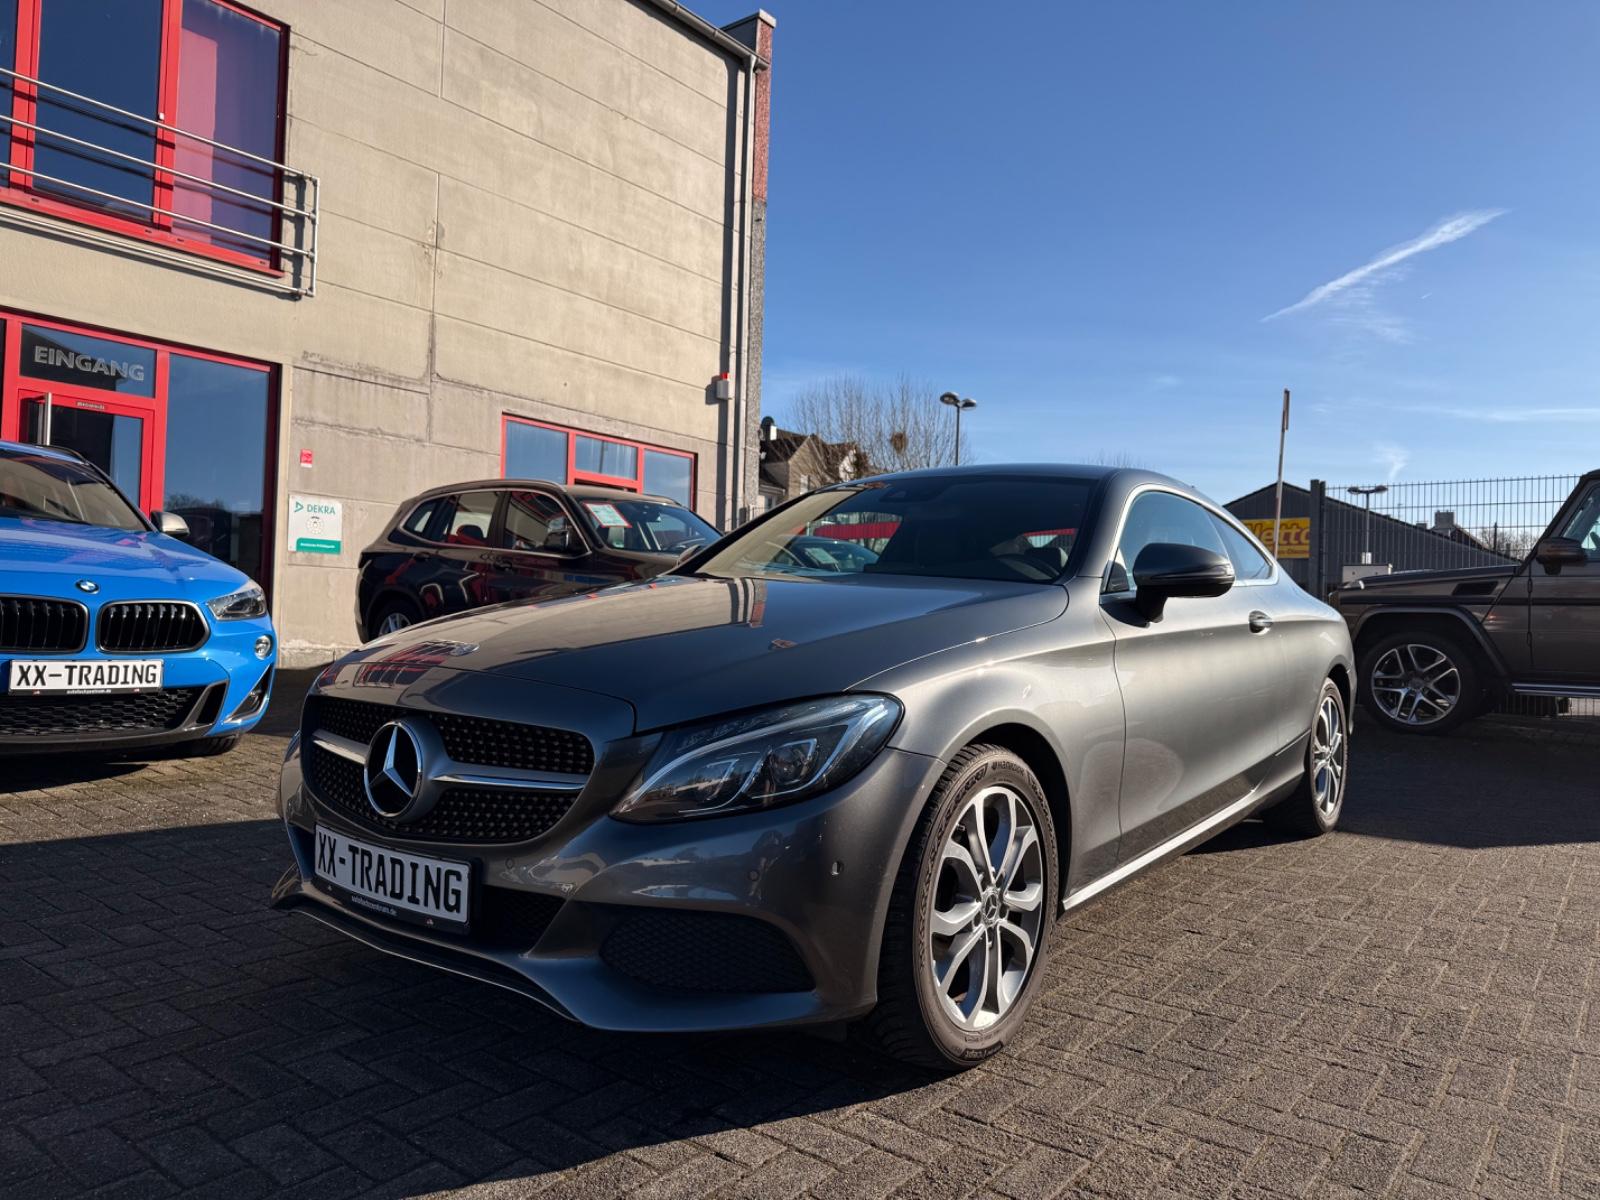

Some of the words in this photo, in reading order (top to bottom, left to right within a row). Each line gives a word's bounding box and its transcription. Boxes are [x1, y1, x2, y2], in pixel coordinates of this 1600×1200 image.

[34, 346, 144, 381] EINGANG
[307, 504, 336, 515] DEKRA
[16, 664, 158, 687] XX-TRADING
[318, 831, 463, 914] XX-TRADING
